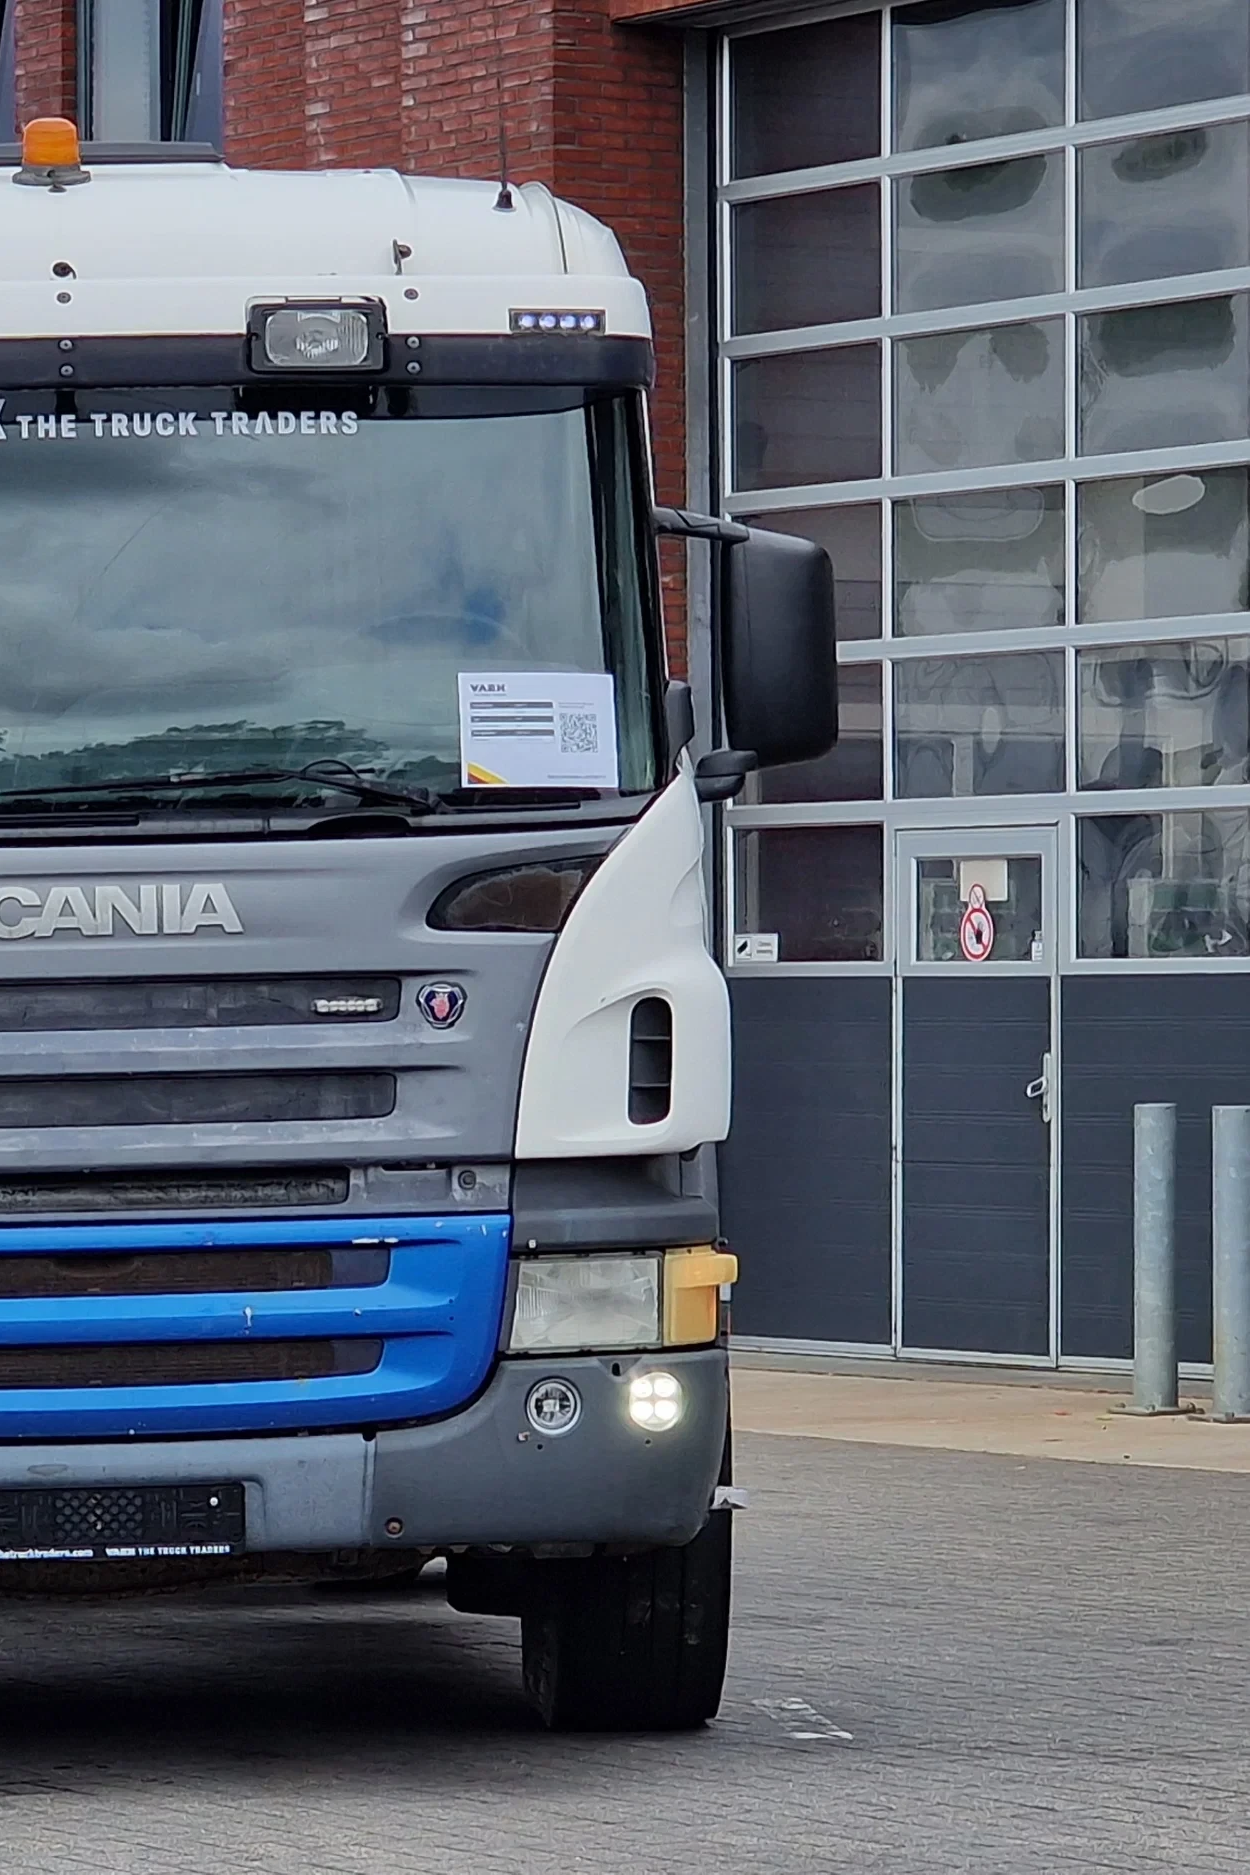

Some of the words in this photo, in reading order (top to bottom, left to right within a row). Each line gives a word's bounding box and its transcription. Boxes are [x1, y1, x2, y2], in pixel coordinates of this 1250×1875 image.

[16, 414, 77, 439] THE
[90, 412, 198, 436] TRUCK
[211, 410, 359, 435] TRADERS
[157, 1546, 188, 1555] TRUCK
[189, 1545, 230, 1554] TRADERS
